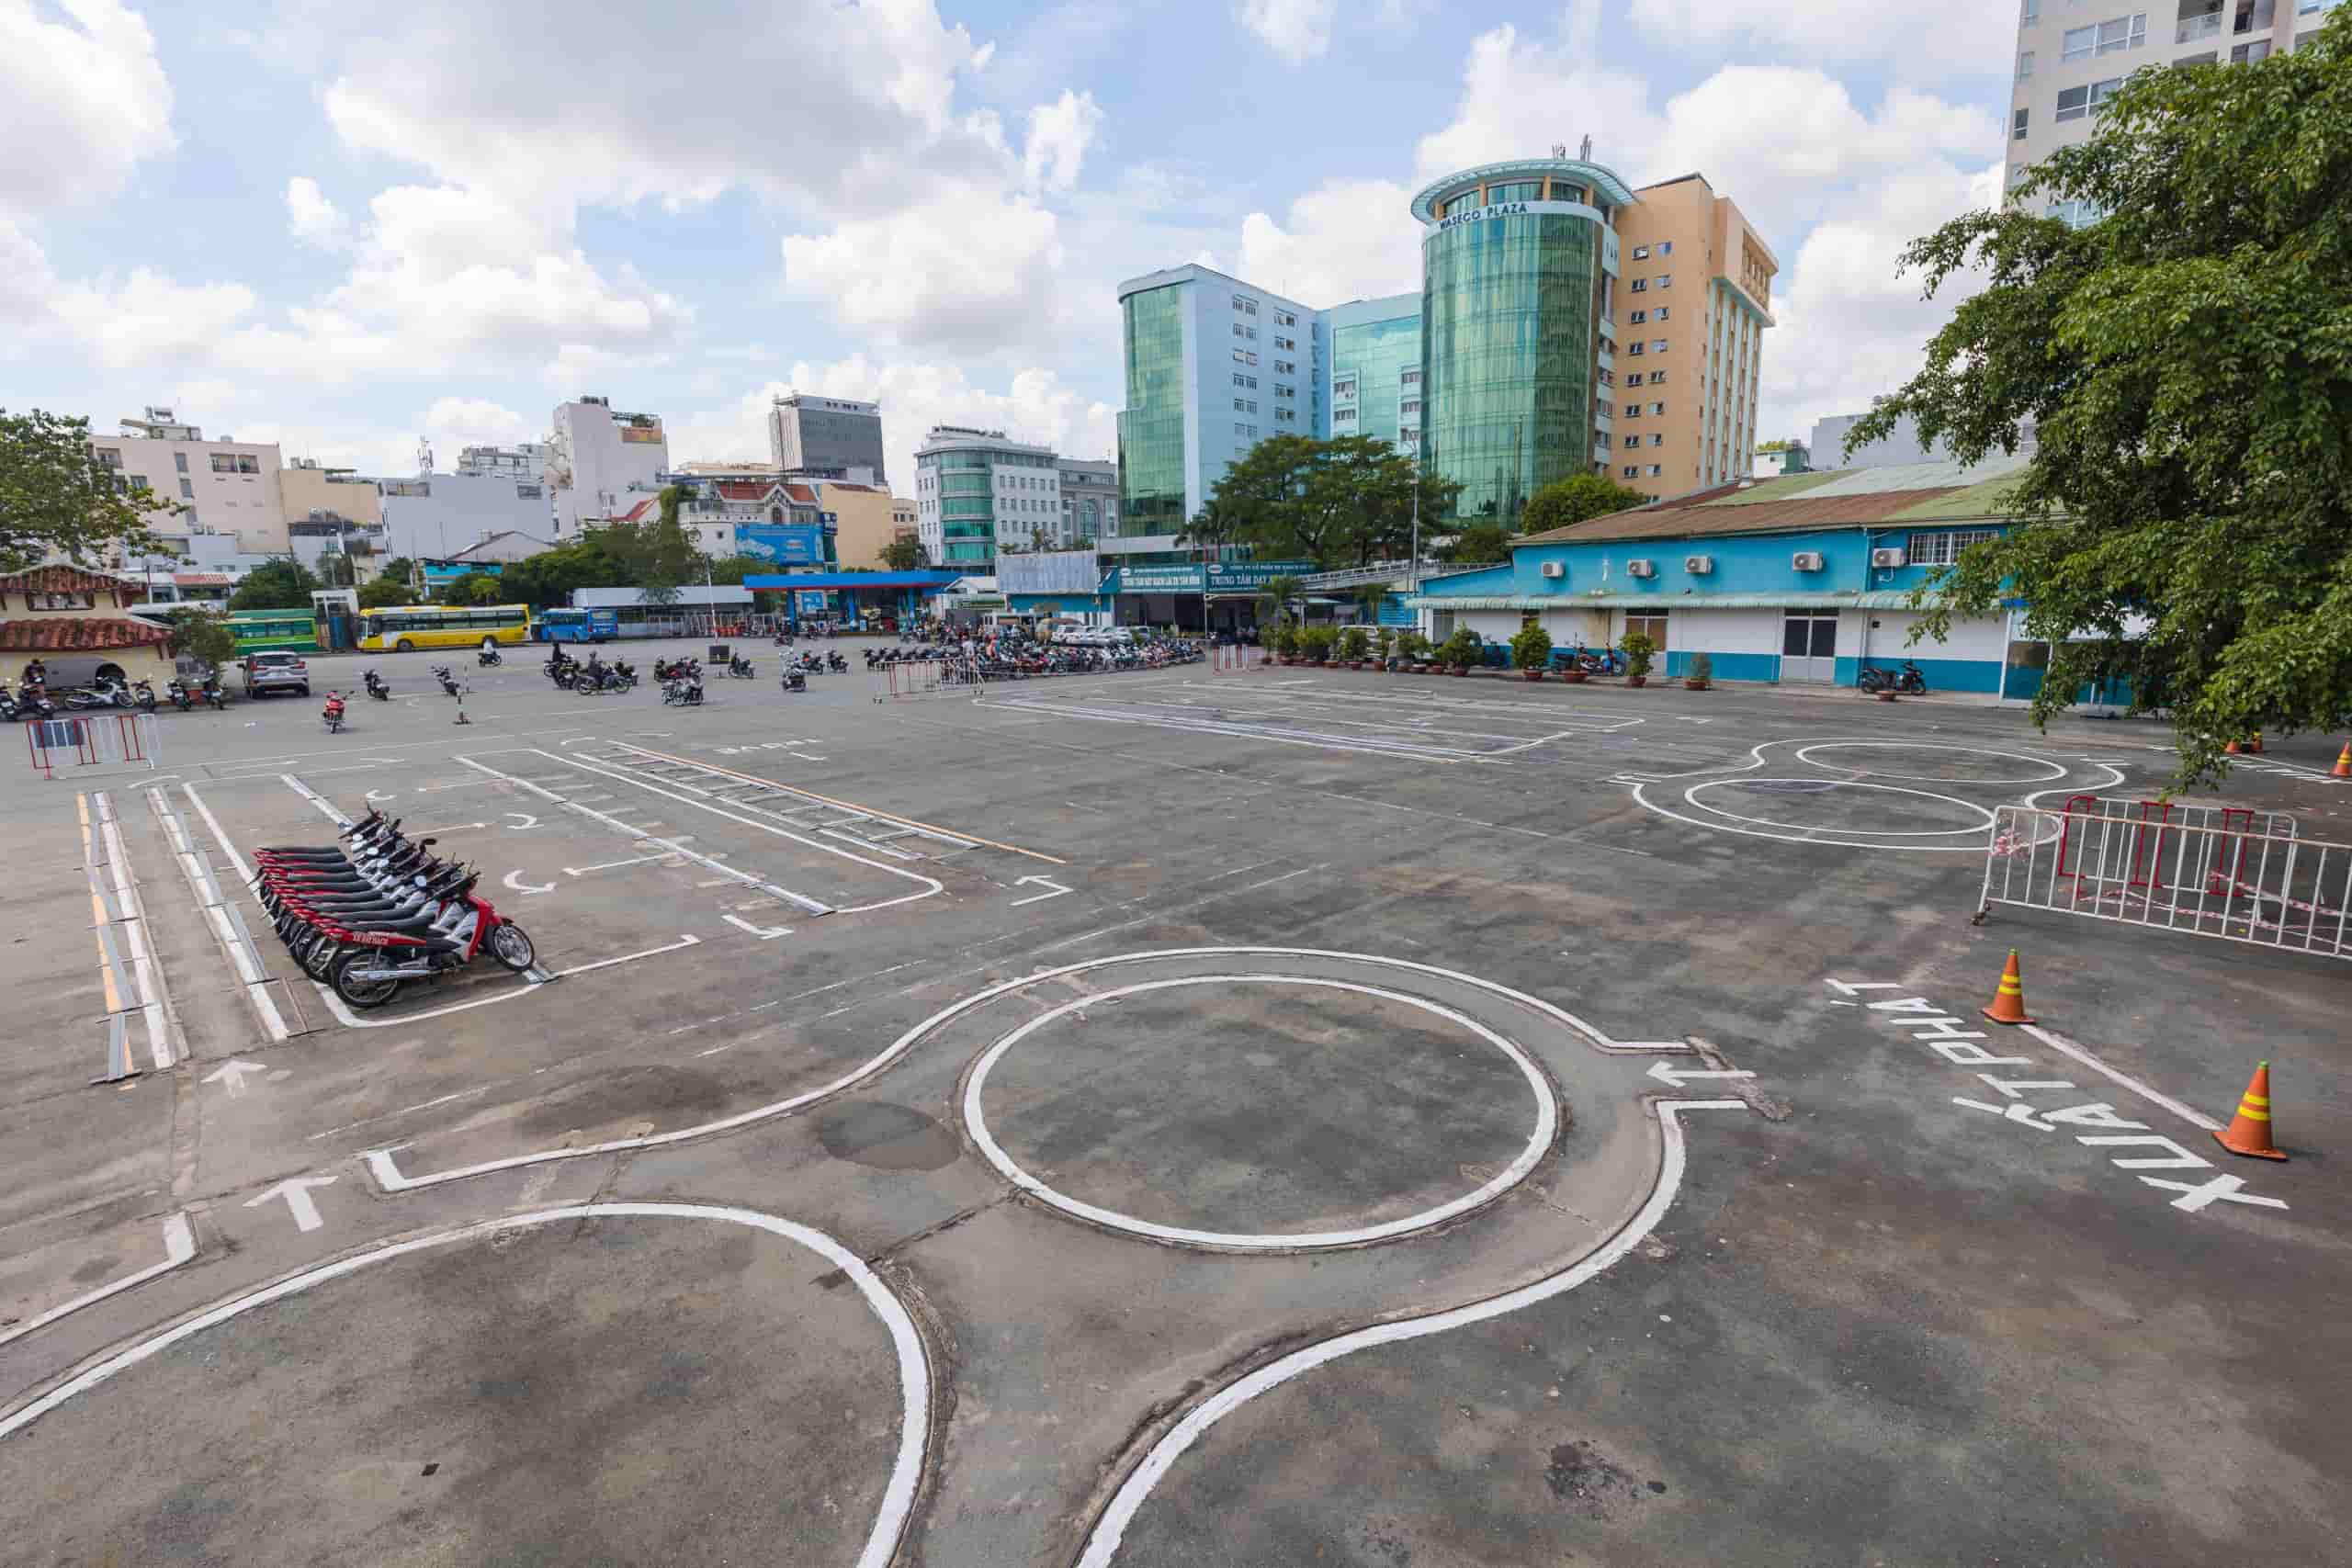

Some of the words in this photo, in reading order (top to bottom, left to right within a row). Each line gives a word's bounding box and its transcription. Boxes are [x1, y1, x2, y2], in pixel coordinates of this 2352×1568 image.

[1487, 203, 1527, 216] PLAZA
[1824, 978, 2032, 1066] PHÁT
[1952, 1073, 2290, 1213] XUẤT
